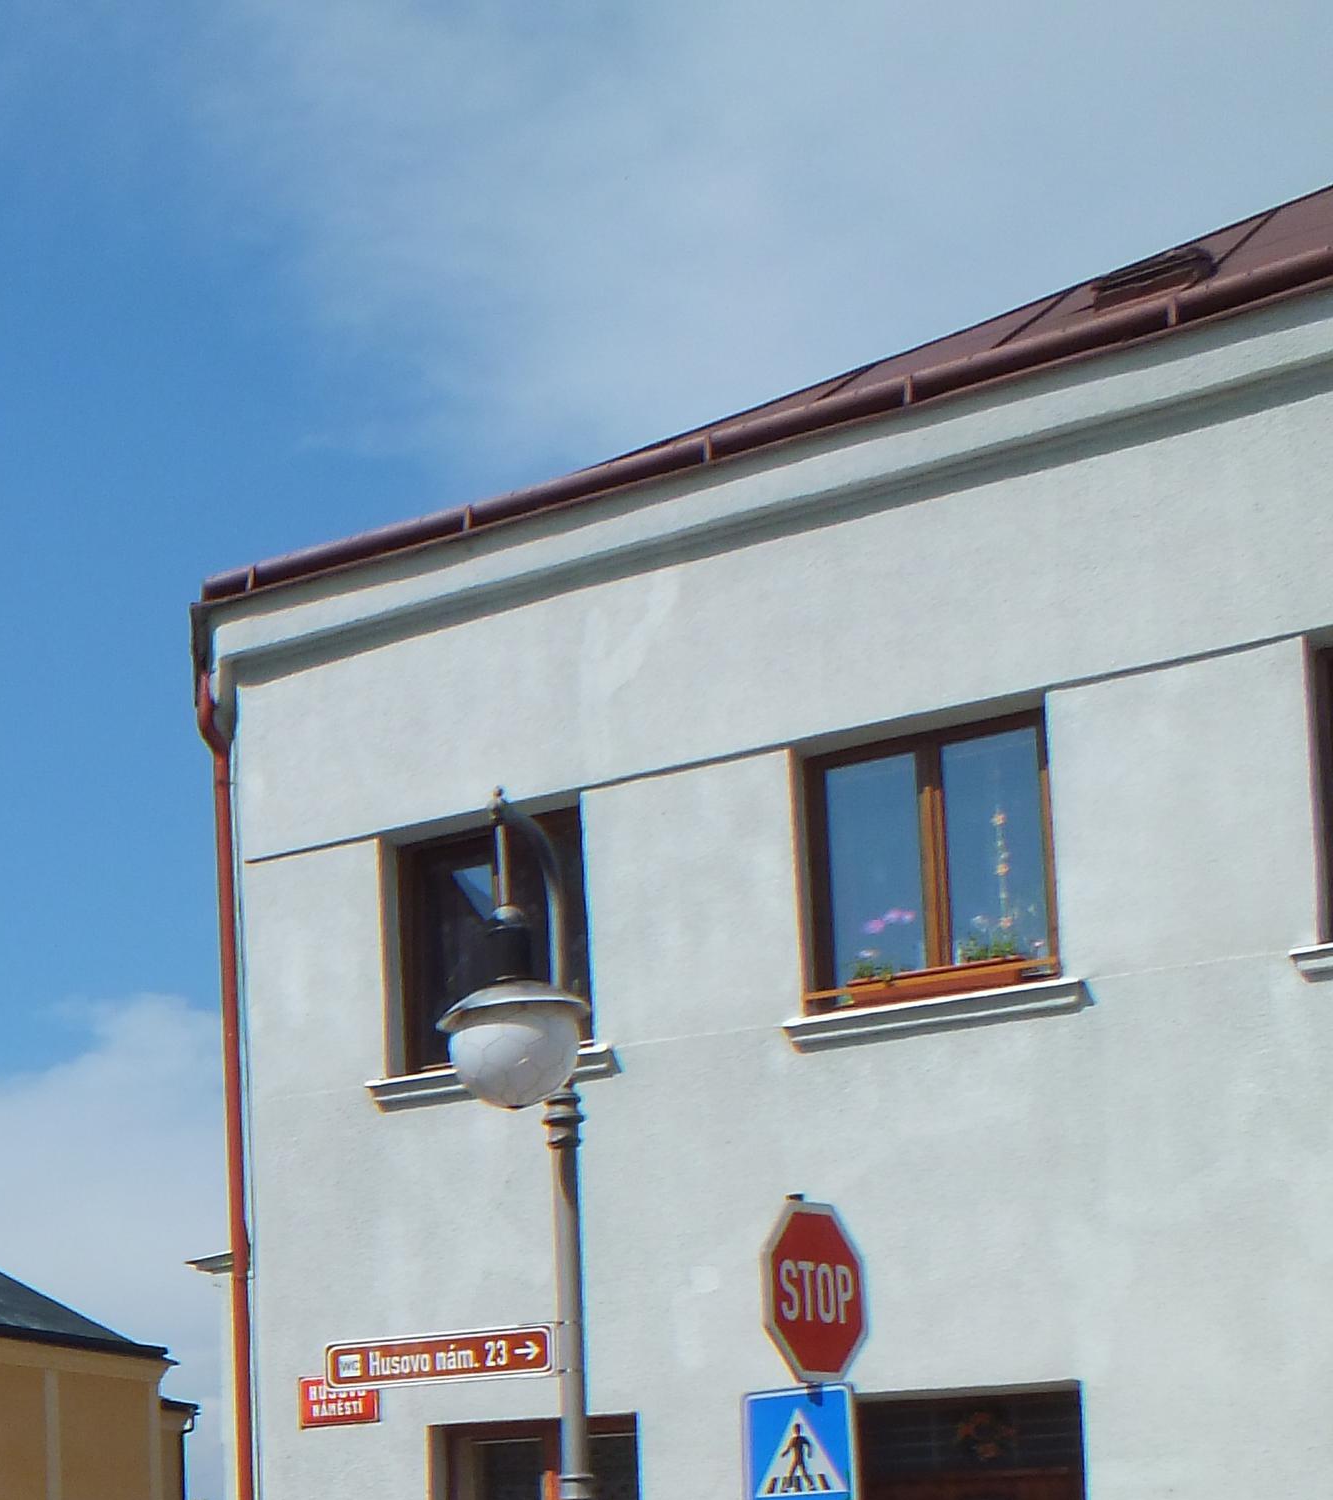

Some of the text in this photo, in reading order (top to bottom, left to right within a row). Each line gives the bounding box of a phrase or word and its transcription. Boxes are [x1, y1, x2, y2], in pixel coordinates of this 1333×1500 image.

[780, 1259, 853, 1324] STOP
[340, 1340, 508, 1376] WC Husovo nám. 23
